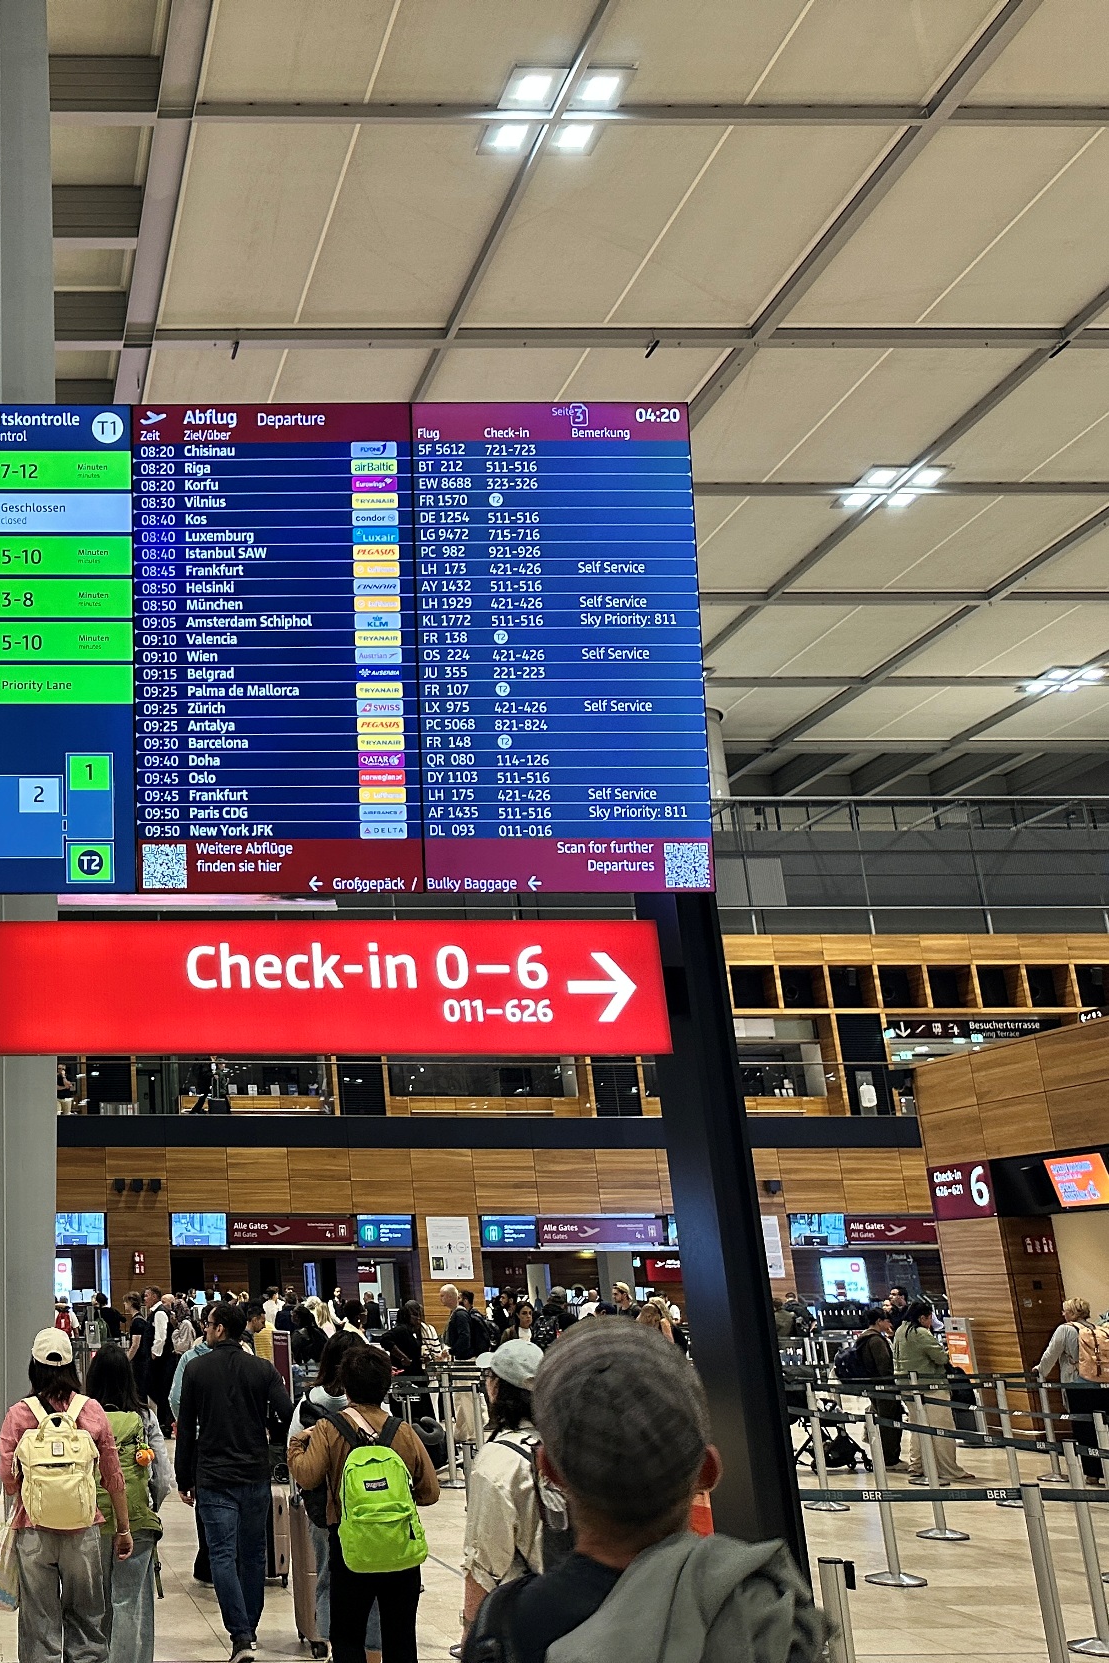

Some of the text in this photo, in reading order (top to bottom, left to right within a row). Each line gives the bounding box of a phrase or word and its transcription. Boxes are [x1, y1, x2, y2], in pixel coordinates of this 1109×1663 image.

[551, 407, 574, 416] Seite
[574, 408, 584, 421] 3
[635, 408, 680, 422] 04:20
[183, 410, 238, 428] Abflug
[257, 412, 325, 429] Departure
[98, 421, 117, 435] T1
[0, 464, 38, 479] 7-12
[77, 463, 108, 471] Minuten
[0, 503, 66, 513] Geschlossen
[0, 516, 27, 525] closed
[1, 549, 42, 564] 5-10
[1, 592, 34, 607] 3-8
[1, 635, 43, 650] 5-10
[1, 680, 72, 693] Priority Lane
[143, 702, 226, 715] 09:25 Zürich
[373, 704, 401, 712] SWISS
[425, 701, 470, 713] LX 975
[494, 702, 547, 713] 421-426
[583, 700, 653, 712] Self Service
[85, 764, 93, 781] 1
[33, 786, 45, 803] 2
[145, 824, 273, 837] 09:50 New York JFK
[429, 825, 475, 837] DL 093
[498, 825, 552, 837] 011-016
[196, 842, 293, 856] Weitere Abflüge
[557, 841, 654, 854] Scan for further
[79, 856, 100, 870] T2
[196, 860, 282, 872] finden sie hier
[587, 860, 655, 874] Departures
[332, 877, 405, 892] Großgepäck
[426, 877, 461, 891] Bulky
[464, 878, 517, 892] Baggage
[185, 943, 417, 991] Check-in
[969, 1021, 1040, 1030] Besucherterrasse
[933, 1170, 962, 1183] Check-in
[970, 1165, 990, 1207] 6
[233, 1222, 269, 1230] Alle Gates
[542, 1224, 579, 1232] Alle Gates
[849, 1222, 885, 1230] Alle Gates
[862, 1491, 882, 1501] BER
[986, 1490, 1007, 1499] BER
